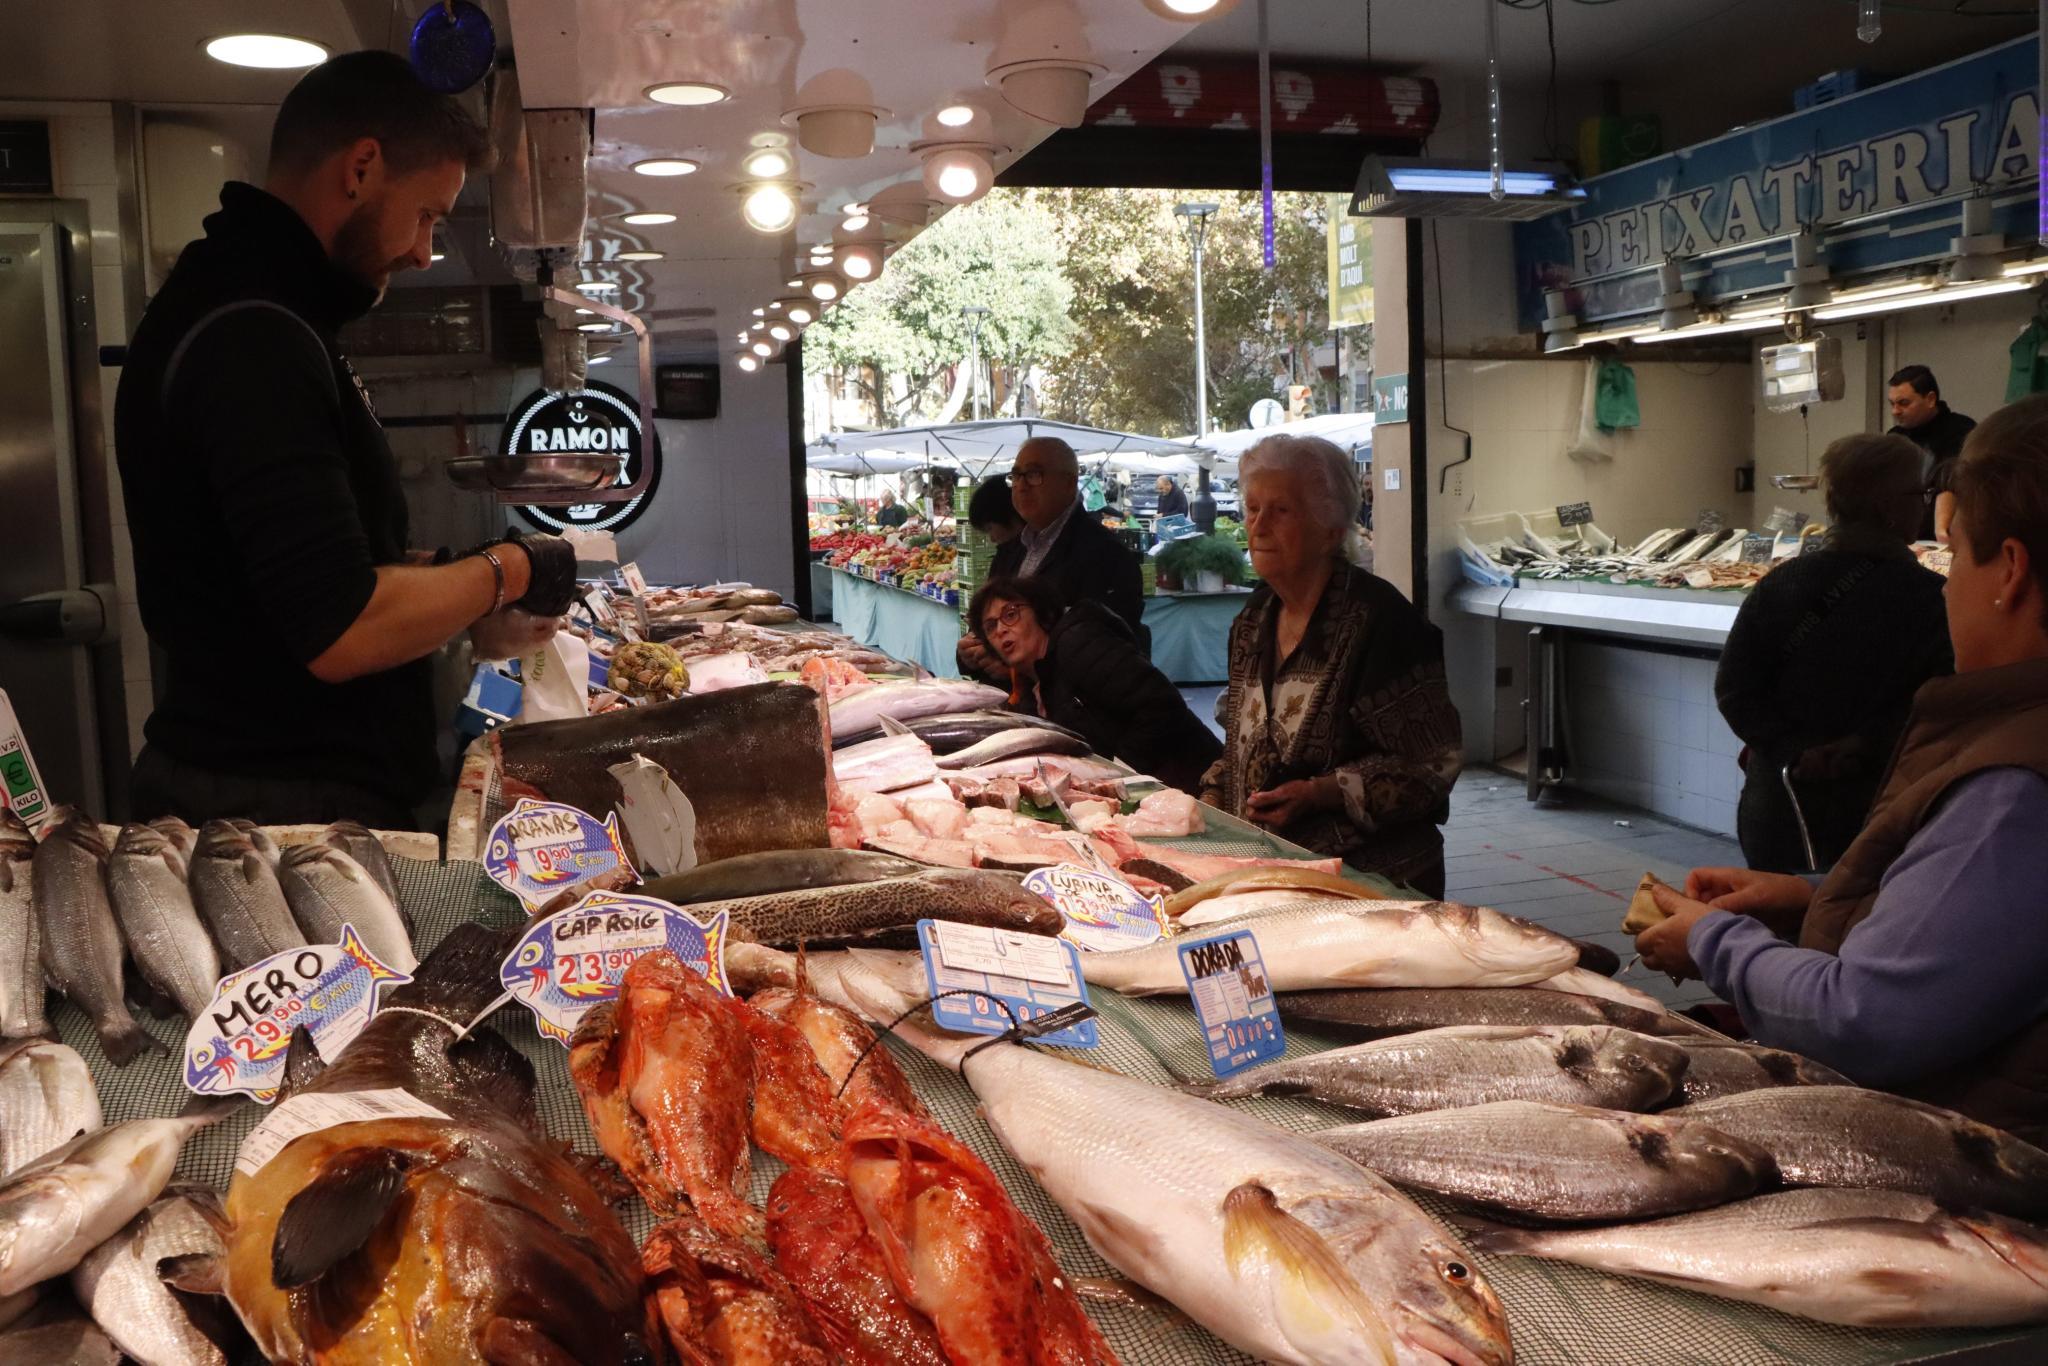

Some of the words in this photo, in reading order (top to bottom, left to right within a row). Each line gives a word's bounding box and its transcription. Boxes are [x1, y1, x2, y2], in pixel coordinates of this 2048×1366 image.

[1569, 92, 2040, 281] PEIXATERIA
[530, 427, 629, 451] RAMON
[16, 793, 38, 807] KILO
[1051, 873, 1112, 892] LUBINA
[555, 916, 602, 941] CAP
[606, 911, 659, 933] ROIG
[212, 952, 322, 1037] MERO
